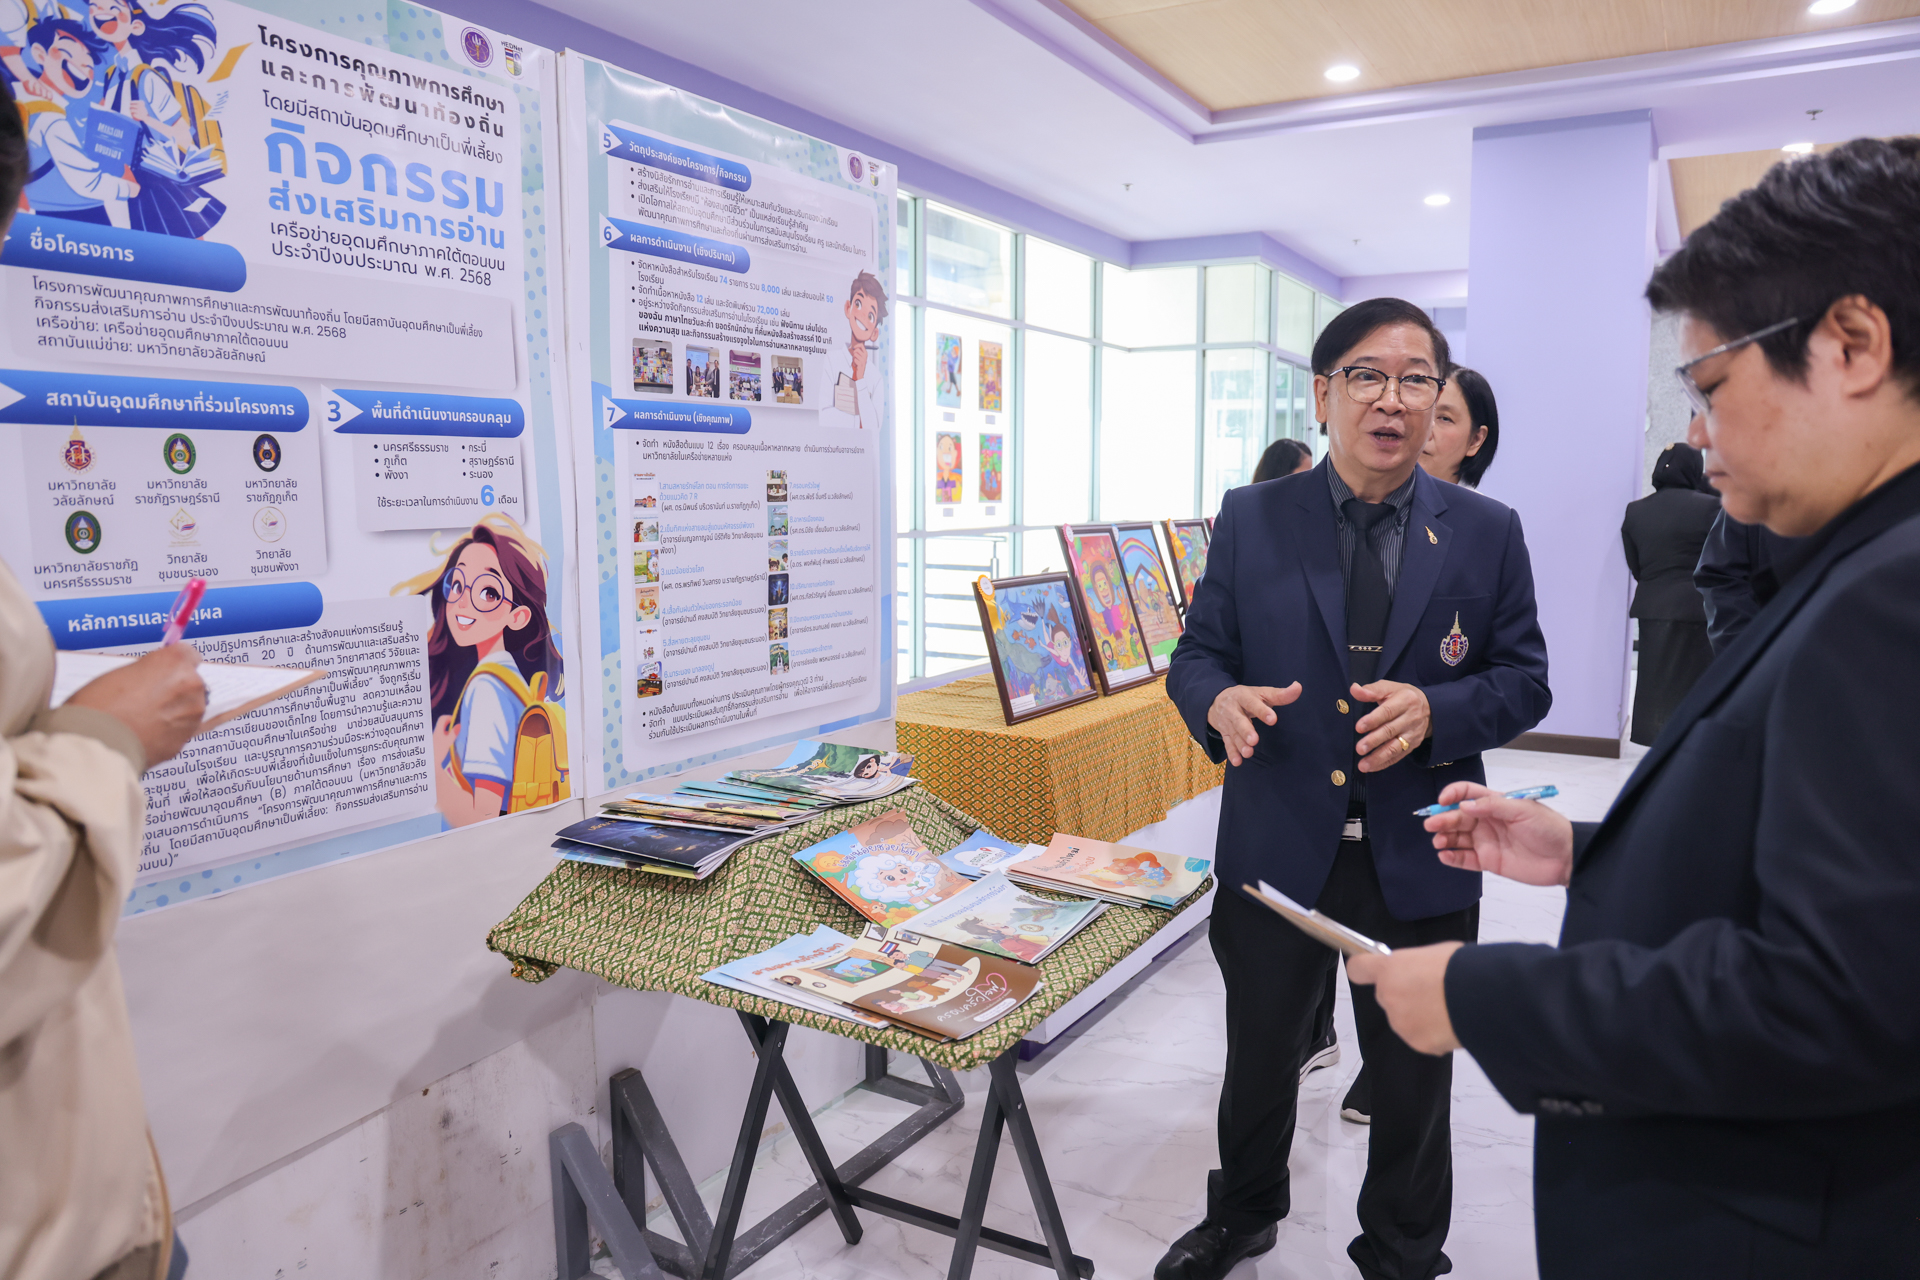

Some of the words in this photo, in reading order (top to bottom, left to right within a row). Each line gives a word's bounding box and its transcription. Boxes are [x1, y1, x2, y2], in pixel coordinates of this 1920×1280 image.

[258, 24, 504, 114] โครงการคุณภาพการศึกษา
[261, 59, 504, 138] และการพัฒนาท้องถิ่น
[263, 89, 503, 164] โดยมีสถาบันอุดมศึกษาเป็นพี่เลี้ยง
[603, 133, 612, 150] 5
[264, 117, 503, 218] กิจกรรม
[629, 140, 746, 183] วัตถุประสงค์ของโครงการ/กิจกรรม
[268, 180, 505, 250] ส่งเสริมการอ่าน
[637, 179, 698, 203] ส่งเสริมให้โรงเรียนมี
[749, 208, 808, 235] เป็นแหล่งเรียนรู้สำคัญ
[603, 226, 612, 242] 6
[30, 227, 135, 263] ชื่อโครงการ
[270, 220, 505, 271] เครือข่ายอุดมศึกษาภาคใต้ตอนบน
[630, 233, 691, 252] ผลการดำเนินงาน
[693, 242, 734, 264] (เชิงปริมาณ)
[272, 241, 417, 275] ประจำปีงบประมาณ
[425, 264, 454, 280] พ.ศ.
[460, 268, 492, 287] 2568
[638, 259, 717, 282] จัดหาหนังสือสำหรับโรงเรียน
[720, 275, 727, 283] 74
[729, 278, 748, 288] รายการ
[749, 282, 759, 290] รวม
[761, 283, 779, 293] 8,000
[638, 270, 663, 284] โรงเรียน
[32, 275, 341, 323] โครงการพัฒนาคุณภาพการศึกษาและการพัฒนาท้องถิ่น
[343, 312, 483, 338] โดยมีสถาบันอุดมศึกษาเป็นพี่เลี้ยง
[638, 280, 694, 301] จัดทำเนื้อหาหนังสือ
[696, 294, 702, 302] 12
[704, 295, 714, 305] เล่ม
[715, 299, 755, 312] และจัดพิมพ์รวม
[757, 305, 778, 315] 72,000
[780, 308, 789, 317] เล่ม
[34, 296, 186, 323] กิจกรรมส่งเสริมการอ่าน
[190, 312, 288, 334] ประจำปีงบประมาณ
[292, 323, 314, 336] พ.ศ.
[317, 325, 347, 339] 2568
[638, 307, 662, 320] ของฉัน
[664, 314, 713, 327] ภาษาไทยวันละคำ
[715, 322, 752, 333] ยอดรักนักอ่าน
[822, 336, 831, 344] นาที
[805, 322, 827, 333] เล่มโปรด
[36, 315, 99, 332] เครือข่าย:
[104, 320, 288, 349] เครือข่ายอุดมศึกษาภาคใต้ตอนบน
[638, 321, 679, 337] แห่งความสุข
[38, 333, 133, 353] สถาบันแม่ข่าย:
[137, 342, 266, 363] มหาวิทยาลัยวลัยลักษณ์
[46, 390, 295, 416] สถาบันอุดมศึกษาที่ร่วมโครงการ
[327, 400, 341, 422] 3
[371, 400, 512, 427] พื้นที่ดำเนินงานครอบคลุม
[607, 407, 616, 423] 7
[634, 410, 691, 421] ผลการดำเนินงาน
[693, 411, 732, 425] (เชิงคุณภาพ)
[383, 441, 449, 453] นครศรีธรรมราช
[468, 440, 487, 453] กระบี่
[642, 438, 658, 447] จัดทำ
[663, 439, 703, 449] หนังสือต้นแบบ
[707, 441, 713, 449] 12
[717, 439, 729, 449] เรื่อง
[732, 440, 800, 452] ครอบคลุมเนื้อหาหลากหลาย
[642, 450, 731, 460] มหาวิทยาลัยในเครือข่ายหลายแห่ง
[383, 455, 407, 469] ภูเก็ต
[147, 478, 208, 489] มหาวิทยาลัย
[245, 478, 298, 489] มหาวิทยาลัย
[384, 469, 409, 480] พังงา
[469, 469, 493, 479] ระนอง
[48, 479, 116, 491] มหาวิทยาลัย
[53, 494, 114, 507] วลัยลักษณ์
[377, 495, 479, 508] ใช้ระยะเวลาในการดำเนินงาน
[480, 484, 495, 507] 6
[498, 494, 518, 504] เดือน
[166, 552, 208, 565] วิทยาลัย
[255, 548, 292, 560] วิทยาลัย
[158, 567, 219, 582] ชุมชนระนอง
[251, 561, 299, 577] ชุมชนพังงา
[43, 574, 133, 590] นครศรีธรรมราช
[261, 649, 275, 659] 20
[287, 646, 293, 656] ปี
[305, 631, 419, 654] ด้านการพัฒนาและเสริมสร้าง
[337, 648, 385, 664] วิทยาศาสตร์
[388, 647, 419, 657] วิจัยและ
[379, 668, 420, 685] จึงถูกริเริ่ม
[809, 675, 812, 683] 3
[362, 681, 421, 700] ลดความเหลื่อม
[319, 697, 422, 720] โดยการนำความรู้และความ
[347, 709, 423, 729] มาช่วยสนับสนุนการ
[649, 717, 665, 727] จัดทำ
[244, 722, 423, 761] และบูรณาการความร่วมมือระหว่างอุดมศึกษา
[179, 761, 350, 803] เพื่อให้สอดรับกับนโยบายด้านการศึกษา
[357, 754, 375, 767] เรื่อง
[381, 746, 425, 761] การส่งเสริม
[270, 785, 286, 800] (B)
[294, 775, 352, 794] ภาคใต้ตอนบน
[359, 758, 425, 781] (มหาวิทยาลัยวลัย
[169, 805, 327, 849] โดยมีสถาบันอุดมศึกษาเป็นพี่เลี้ยง:
[334, 783, 427, 811] กิจกรรมส่งเสริมการอ่าน
[937, 980, 1006, 1022] ครอบครัวใจฟู
